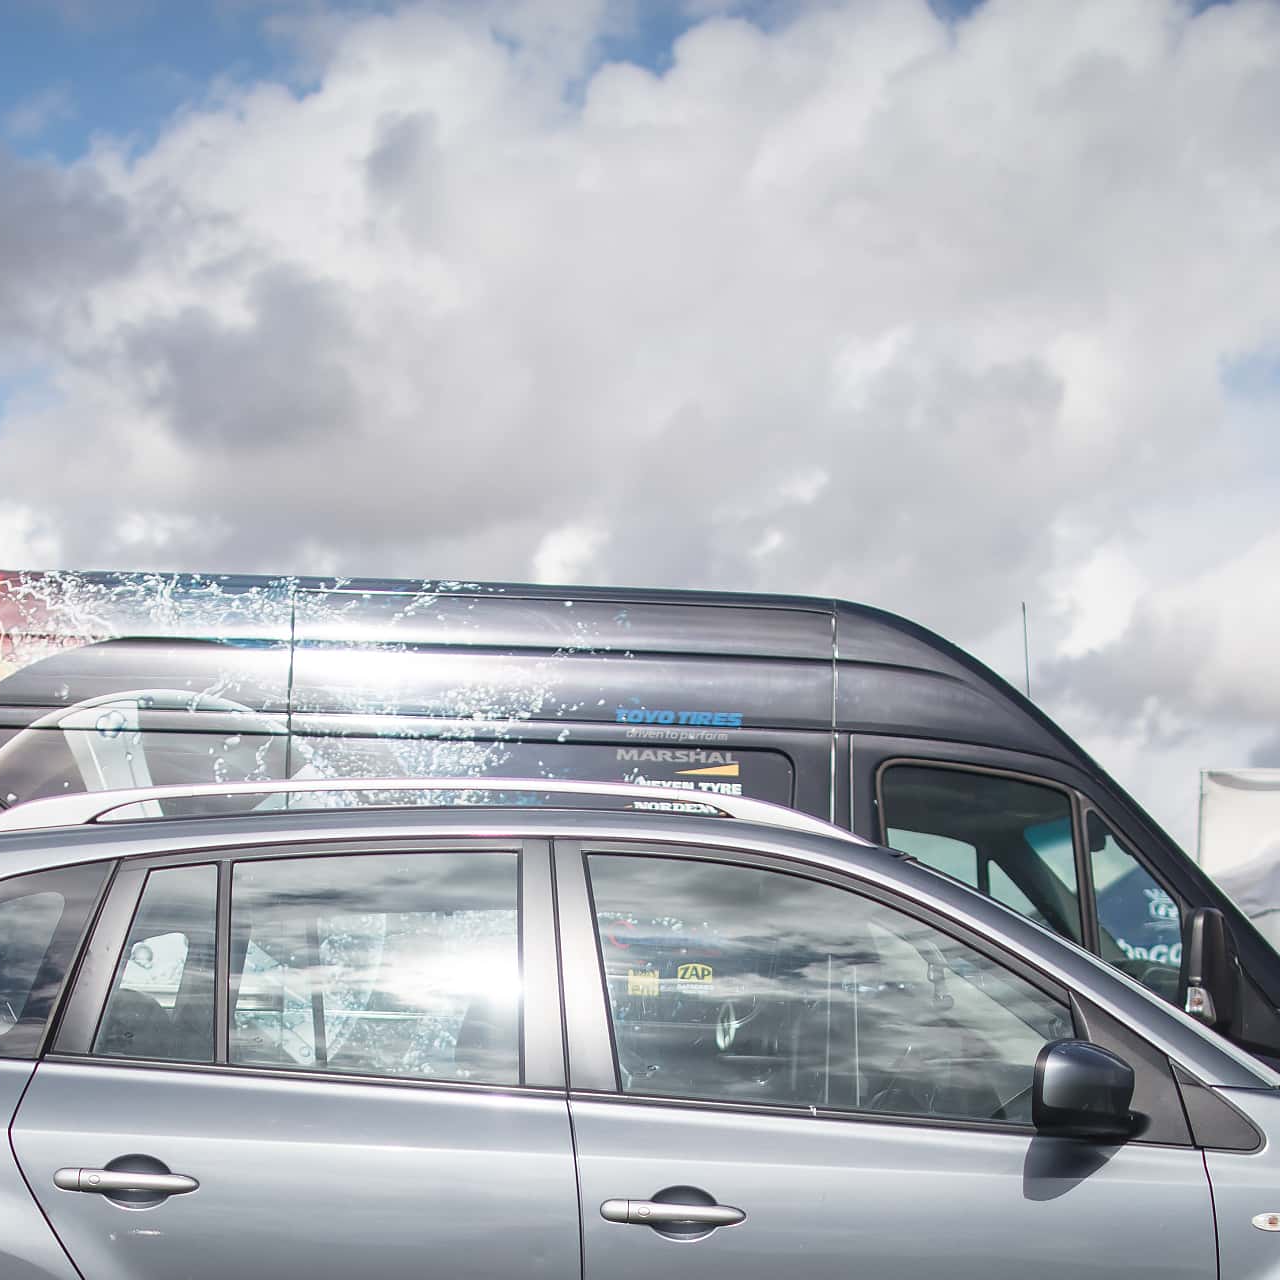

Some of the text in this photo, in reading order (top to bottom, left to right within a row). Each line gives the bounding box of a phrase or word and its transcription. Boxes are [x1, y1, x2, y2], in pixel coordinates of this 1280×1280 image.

[616, 709, 744, 727] TOYO TIRES
[616, 748, 740, 764] MARSHAL
[698, 782, 743, 796] TYRE
[678, 966, 713, 980] ZAP
